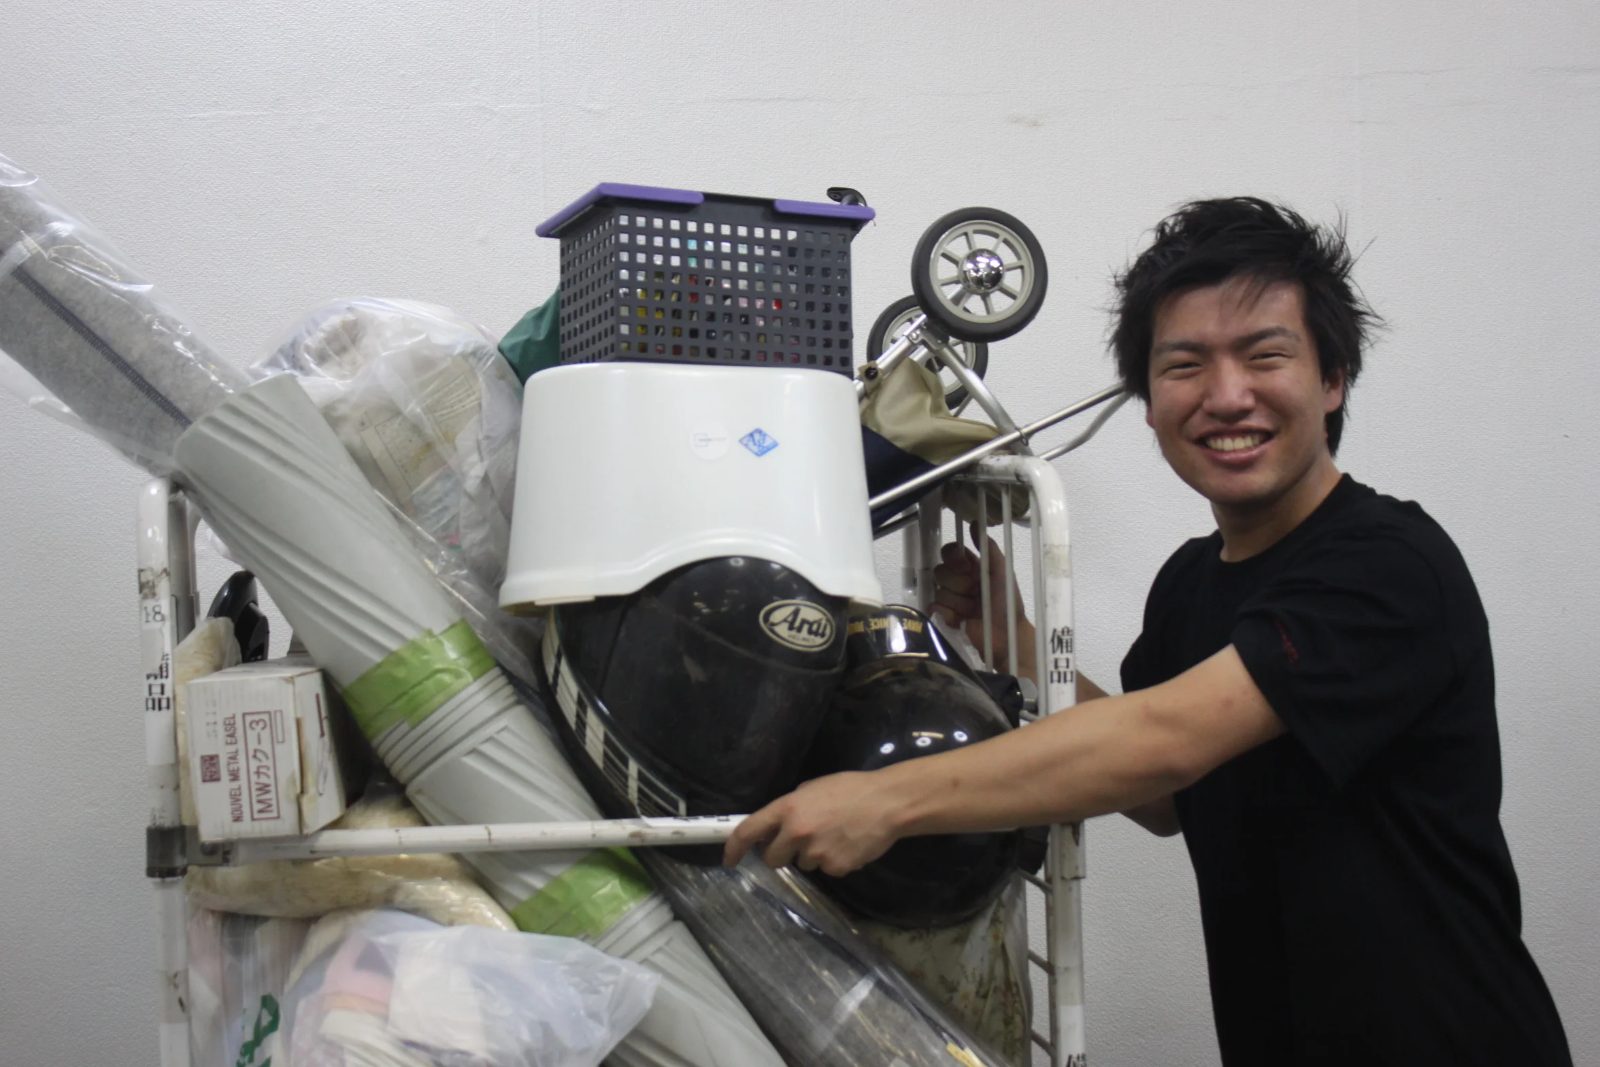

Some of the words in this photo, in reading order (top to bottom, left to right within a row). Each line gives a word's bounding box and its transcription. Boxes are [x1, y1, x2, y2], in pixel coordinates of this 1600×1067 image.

[767, 606, 829, 638] Arai
[1050, 626, 1073, 683] 備品
[223, 713, 239, 746] EASEL
[226, 747, 241, 782] METAL
[229, 785, 244, 823] NOUVEL
